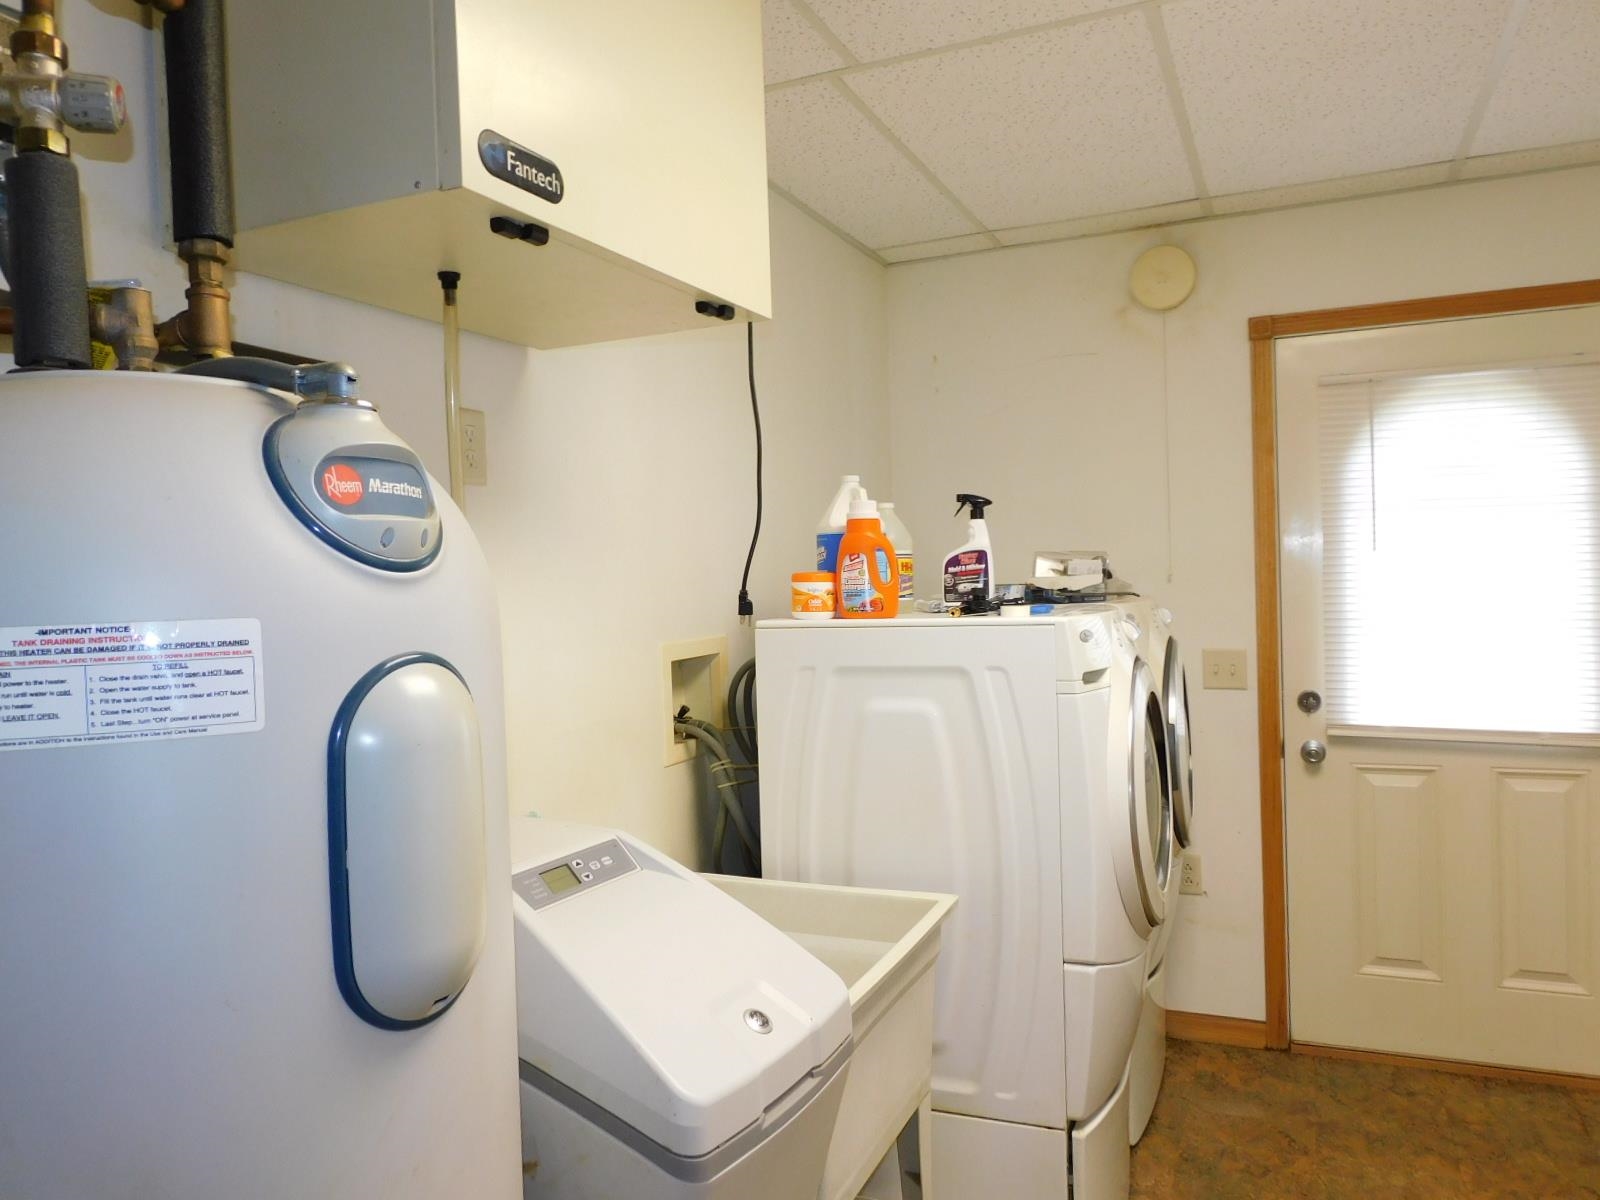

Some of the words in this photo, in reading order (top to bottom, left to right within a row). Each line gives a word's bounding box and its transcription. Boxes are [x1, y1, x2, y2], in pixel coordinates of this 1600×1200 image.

[506, 150, 561, 196] Fantech
[324, 465, 363, 499] Rheem
[368, 477, 423, 500] Marathon
[11, 640, 38, 648] TANK
[40, 637, 86, 646] DRAINING
[18, 648, 52, 656] HEATER
[54, 647, 71, 655] CAN
[73, 646, 84, 654] BE
[87, 645, 127, 653] DAMAGED
[175, 640, 215, 649] PROPERLY
[217, 638, 250, 648] DRAINED
[98, 686, 119, 695] Open
[151, 684, 171, 692] supply
[213, 689, 228, 697] HOT
[100, 708, 120, 716] Close
[133, 706, 149, 714] HOT
[198, 712, 220, 720] service
[3, 714, 26, 722] LEAVE
